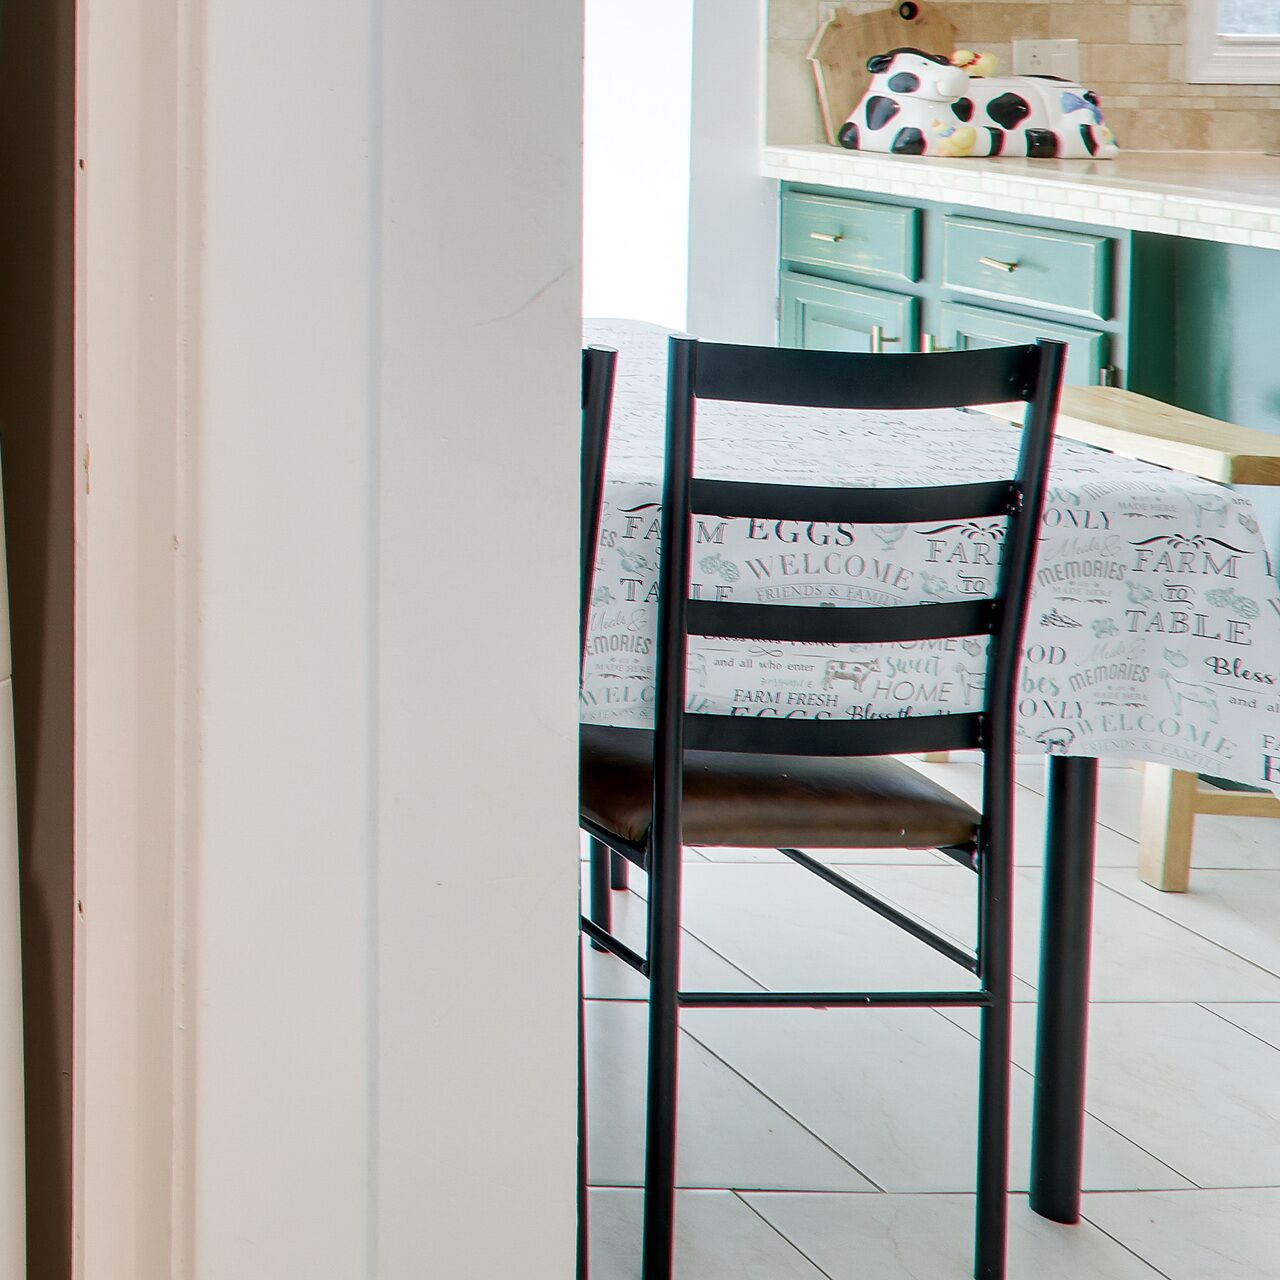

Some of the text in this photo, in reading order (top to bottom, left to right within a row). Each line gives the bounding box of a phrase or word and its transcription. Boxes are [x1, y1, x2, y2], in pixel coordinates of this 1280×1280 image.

[746, 518, 856, 547] EGGS
[1042, 507, 1114, 530] ONLY
[745, 552, 915, 592] WELCOME
[1037, 559, 1128, 588] MEMORIES
[1132, 548, 1242, 579] FARM
[756, 583, 822, 601] FRIENDS
[828, 585, 840, 597] &
[1125, 608, 1252, 646] TABLE
[586, 634, 652, 656] EMORIES
[1027, 644, 1067, 665] OD
[714, 658, 816, 672] and all who enter
[1068, 662, 1150, 693] MEMORIES
[1204, 655, 1277, 686] Bless
[872, 679, 953, 702] HOME
[1022, 665, 1061, 697] bes
[733, 688, 781, 705] FARM
[786, 692, 839, 707] FRESH
[1228, 696, 1280, 714] and al
[1076, 712, 1238, 760] WELCOME
